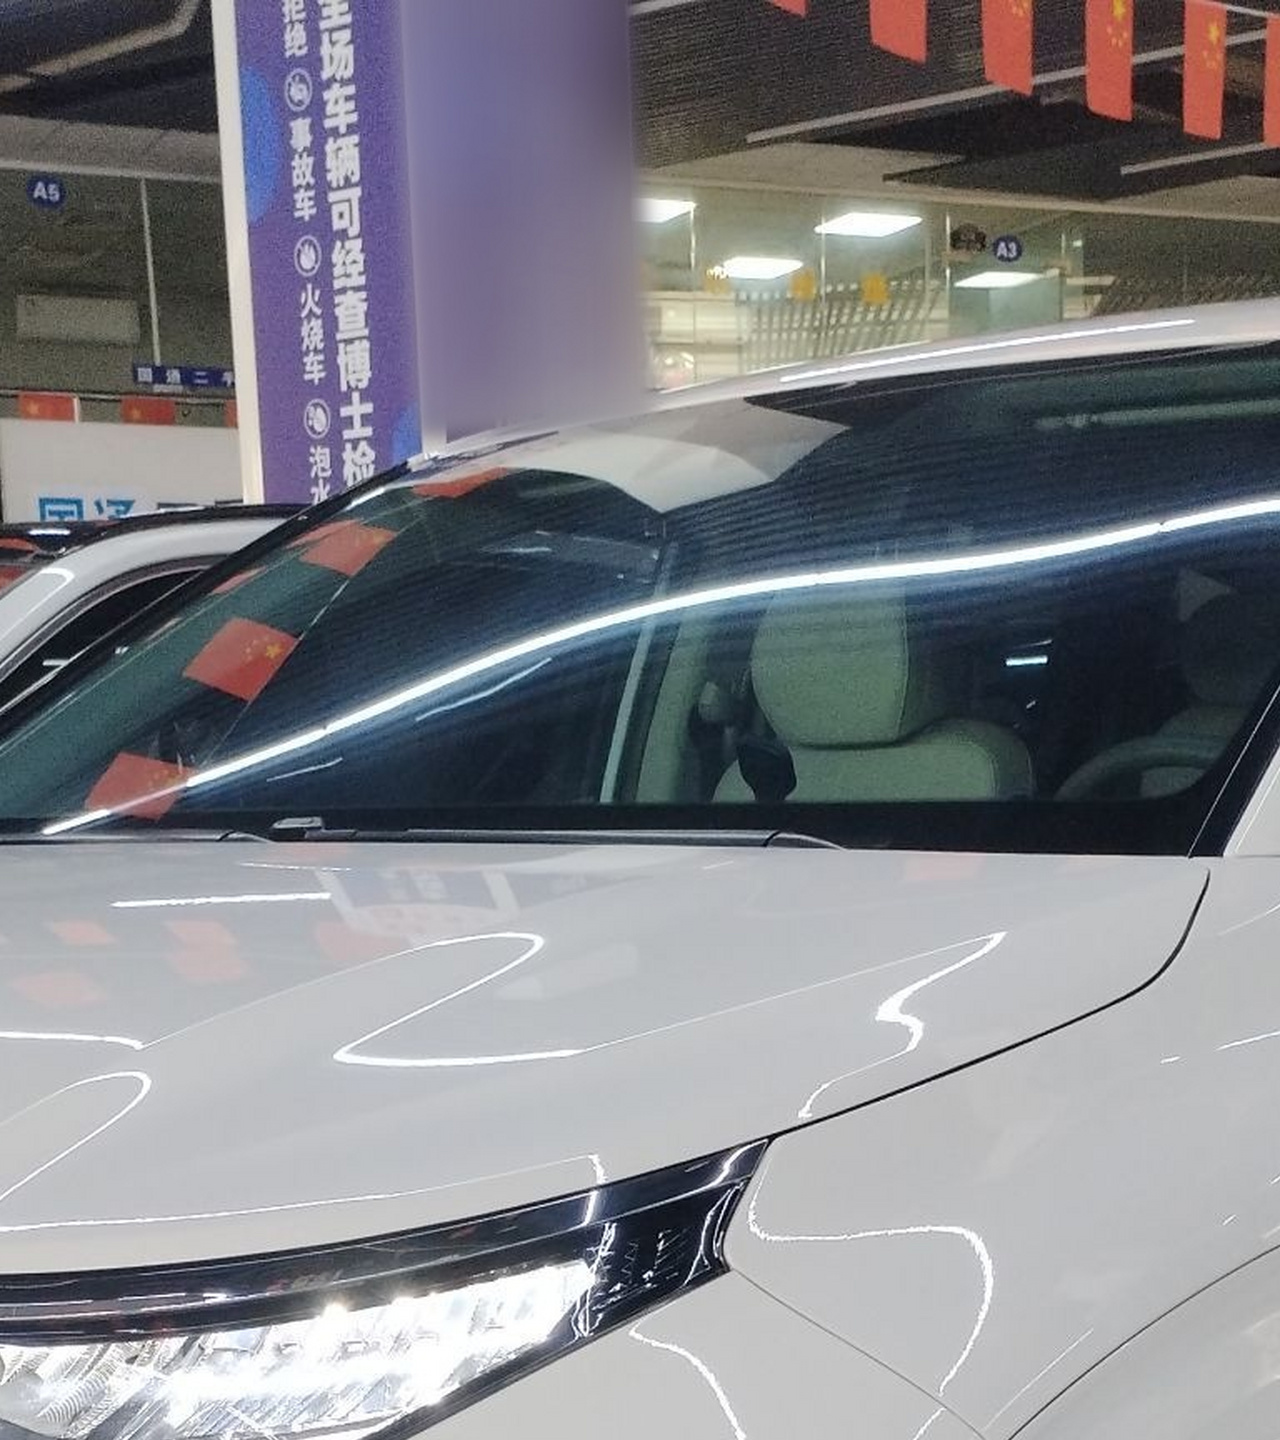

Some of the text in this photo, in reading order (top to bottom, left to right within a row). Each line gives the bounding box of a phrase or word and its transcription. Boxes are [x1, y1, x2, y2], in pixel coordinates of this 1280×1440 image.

[33, 181, 61, 202] A5
[289, 116, 318, 222] 事故车
[997, 240, 1018, 259] A3
[300, 283, 327, 386] 火烧车
